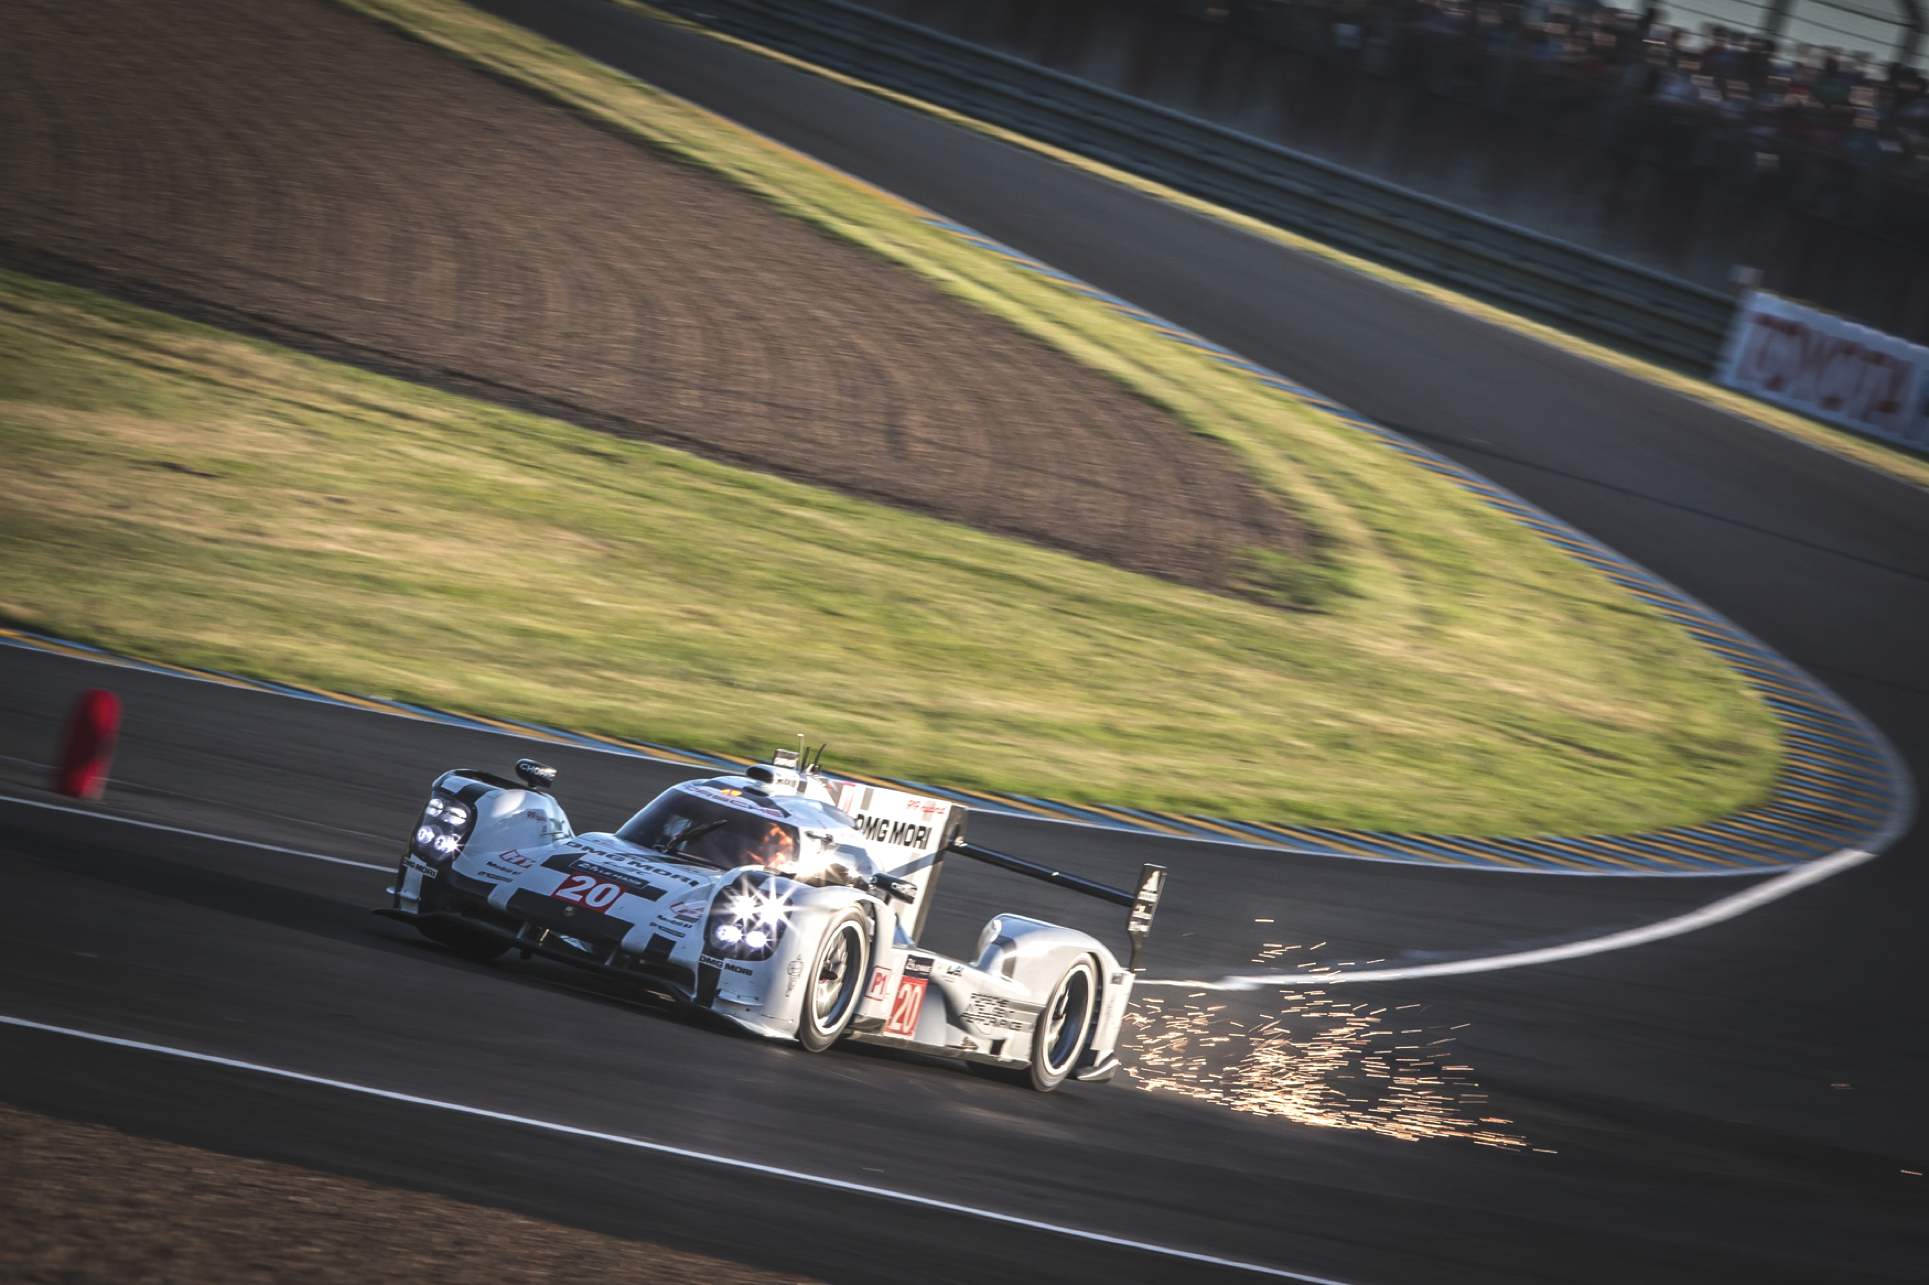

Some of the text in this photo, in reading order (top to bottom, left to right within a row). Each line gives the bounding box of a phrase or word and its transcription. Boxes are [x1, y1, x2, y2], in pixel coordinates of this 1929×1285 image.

[888, 821, 933, 850] MORI
[566, 841, 626, 862] DMG
[627, 860, 700, 887] MORI
[555, 875, 621, 908] 20
[700, 954, 753, 977] DMG MORI
[872, 972, 888, 1000] P1
[890, 983, 922, 1033] 20
